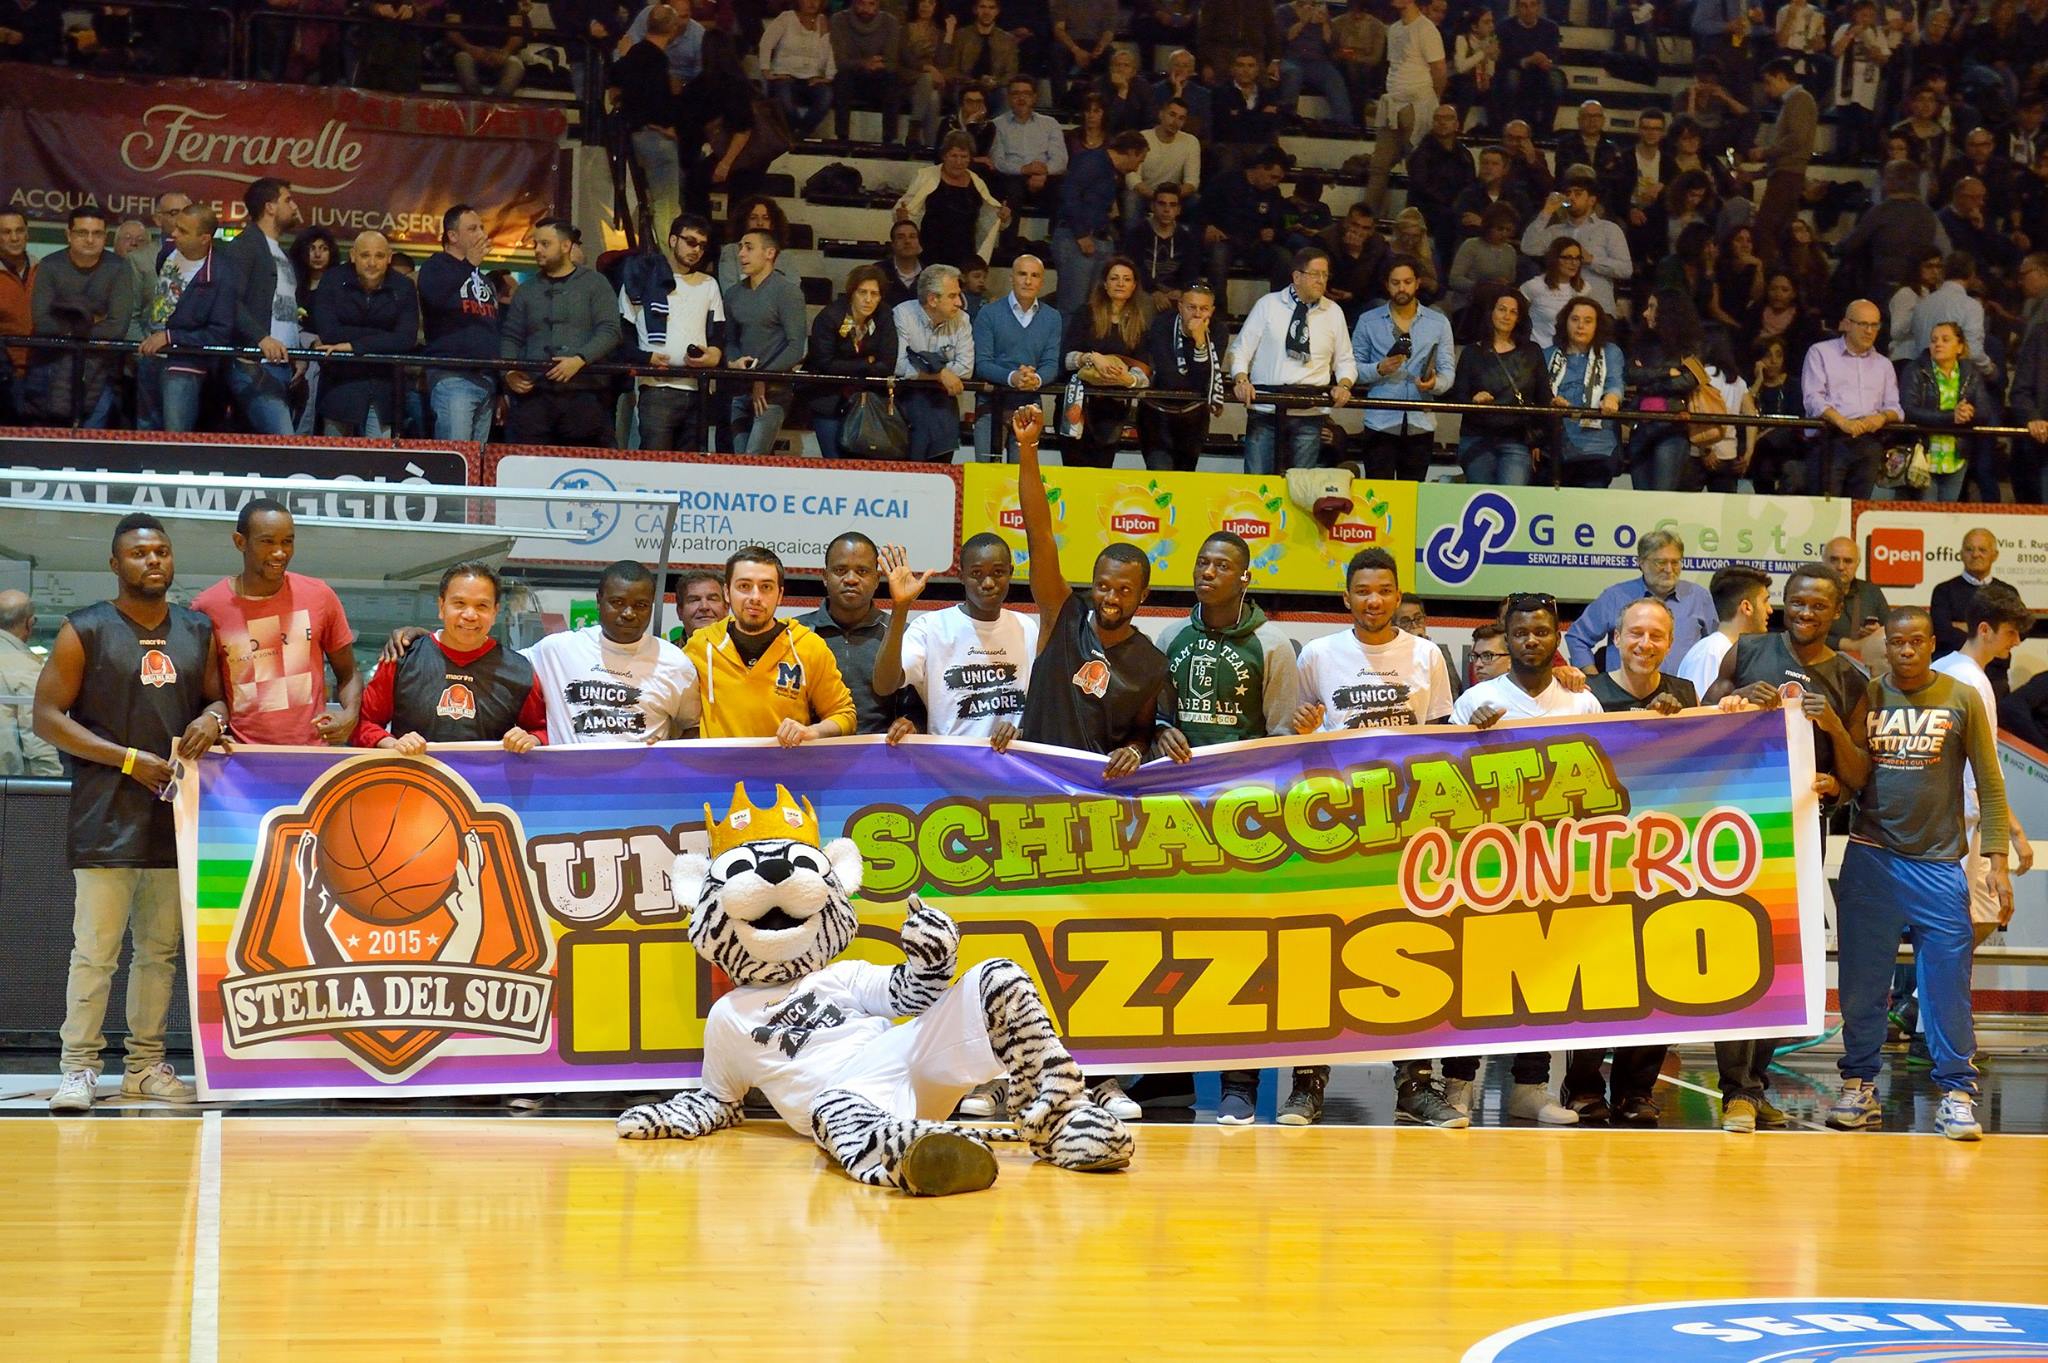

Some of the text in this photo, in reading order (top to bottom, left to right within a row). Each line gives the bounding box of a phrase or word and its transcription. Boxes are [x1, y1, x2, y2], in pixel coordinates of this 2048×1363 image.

[120, 104, 364, 173] Ferrarelle
[9, 187, 99, 213] ACQUA
[635, 488, 909, 519] RONATO E CAF ACAI
[1003, 512, 1024, 528] Lip
[1115, 517, 1156, 532] Lipton
[1225, 521, 1267, 537] Lipton
[1332, 526, 1373, 541] Lipton
[1528, 552, 1560, 564] SERVIZI
[1561, 553, 1578, 565] PER
[1579, 555, 1589, 565] LE
[1590, 555, 1629, 567] IMPRESE:
[1873, 544, 1963, 565] Open offic
[2016, 553, 2047, 564] 81100
[1219, 645, 1250, 681] TEAM
[445, 673, 474, 682] macron
[776, 661, 803, 691] M
[962, 668, 1007, 685] UNICO
[1785, 669, 1811, 683] macron
[579, 686, 627, 702] UNICO
[1350, 688, 1398, 704] UNICO
[968, 694, 1018, 714] AMORE
[1177, 697, 1244, 714] ASEBALL
[583, 716, 637, 730] AMORE
[1357, 714, 1411, 728] AMORE
[1866, 708, 1951, 737] HAVE
[850, 740, 1624, 894] SCHIACCIATA
[1402, 808, 1760, 914] CONTRO
[367, 929, 422, 955] 2015
[572, 899, 1761, 1052] IL AZZISMO
[233, 976, 540, 1028] STELLA DEL SUD
[1671, 1312, 2026, 1343] SERIE
